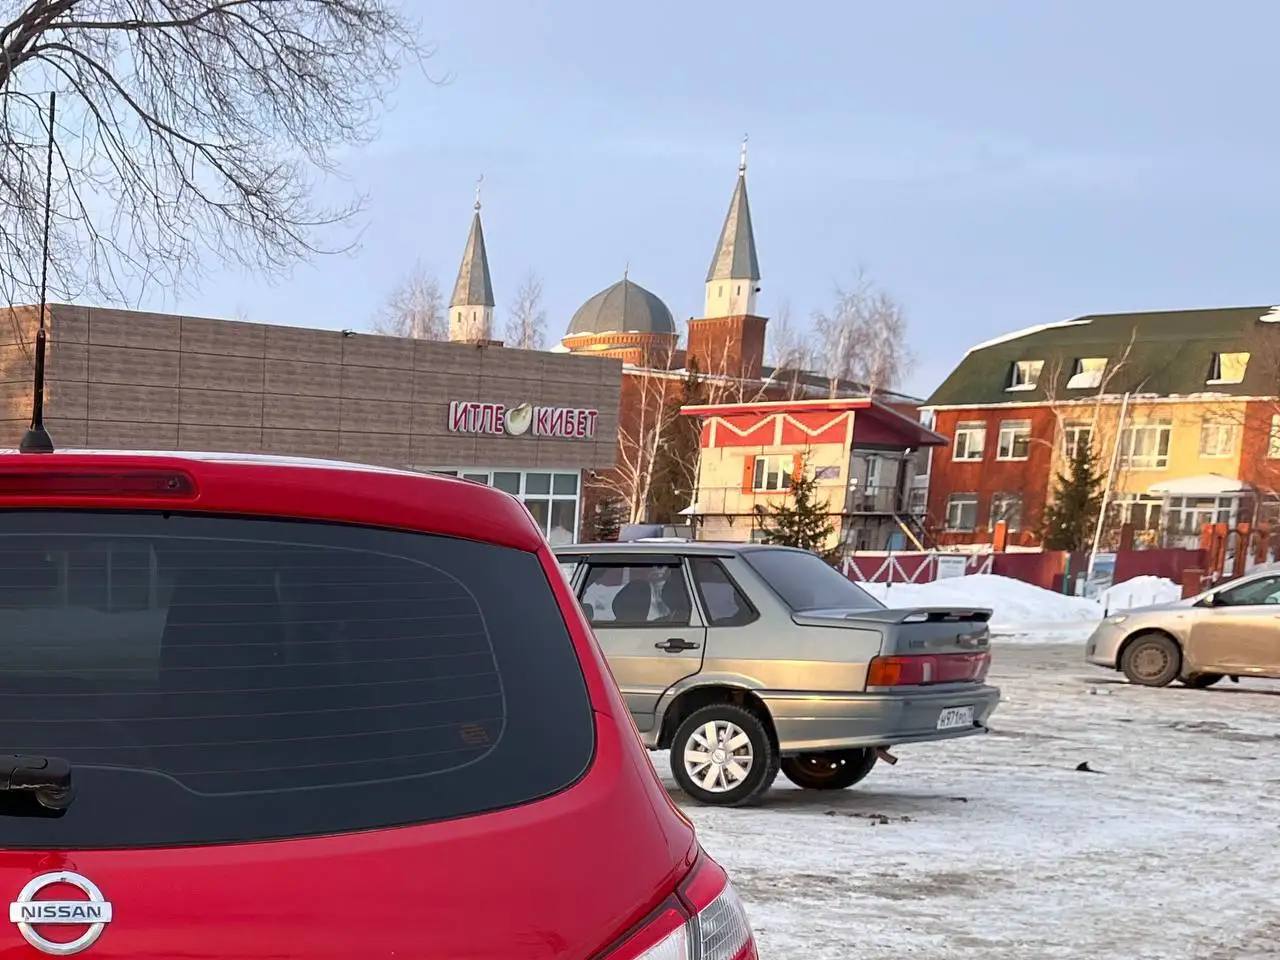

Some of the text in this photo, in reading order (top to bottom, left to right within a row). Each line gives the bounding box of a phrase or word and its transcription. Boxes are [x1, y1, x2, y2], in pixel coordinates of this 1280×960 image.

[450, 401, 598, 437] ИТЛЕ КИБЕТ
[21, 906, 101, 918] NISSAN
